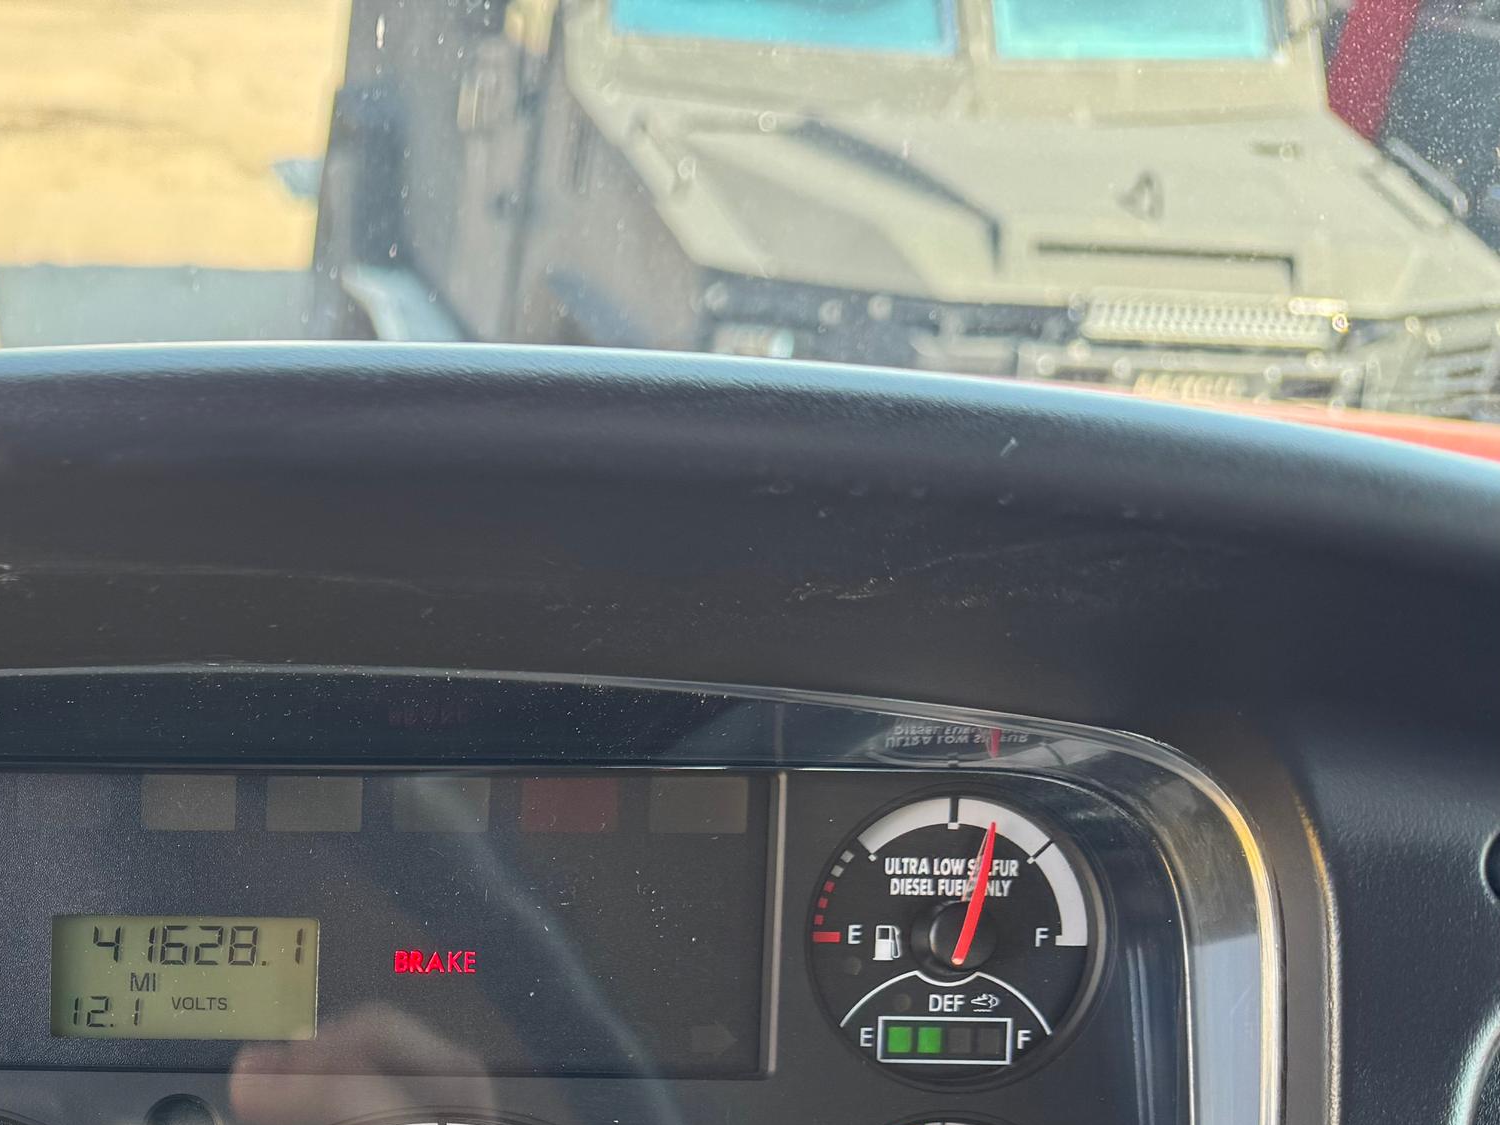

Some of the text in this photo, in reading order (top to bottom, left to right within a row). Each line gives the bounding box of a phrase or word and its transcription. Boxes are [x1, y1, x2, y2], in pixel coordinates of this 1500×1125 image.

[884, 857, 1019, 877] ULTRA LOW SFUR
[890, 878, 935, 896] DIESEL
[848, 924, 862, 944] E
[1035, 928, 1049, 947] F
[394, 950, 477, 974] BRAKE
[130, 972, 157, 992] MI
[73, 996, 140, 1028] 12.1
[171, 997, 228, 1011] VOLTS
[928, 994, 964, 1013] DEF
[860, 1027, 874, 1047] E
[1017, 1030, 1031, 1049] F
